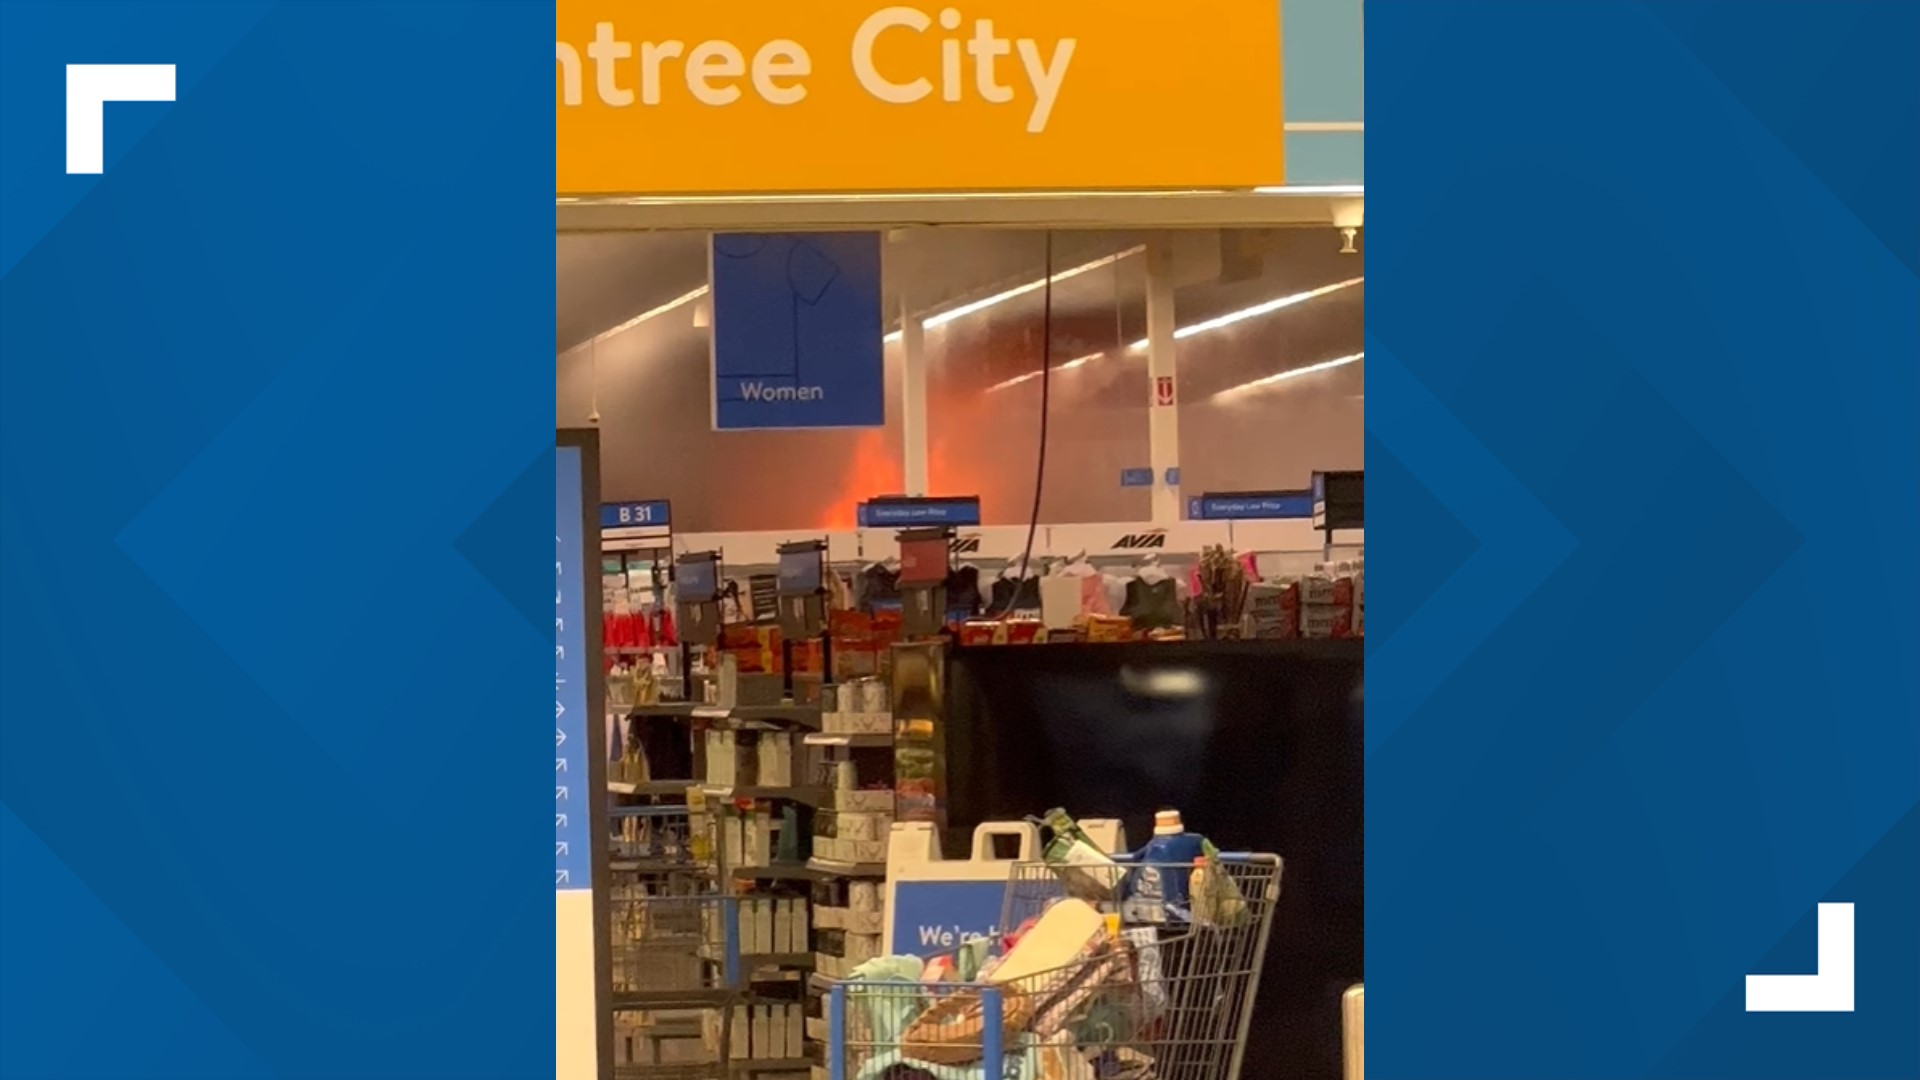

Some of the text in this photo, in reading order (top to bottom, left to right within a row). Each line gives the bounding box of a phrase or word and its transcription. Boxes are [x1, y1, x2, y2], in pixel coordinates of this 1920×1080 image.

[852, 6, 1077, 133] City
[740, 382, 824, 401] Women
[619, 506, 651, 522] B 31
[1111, 533, 1166, 549] AVIA
